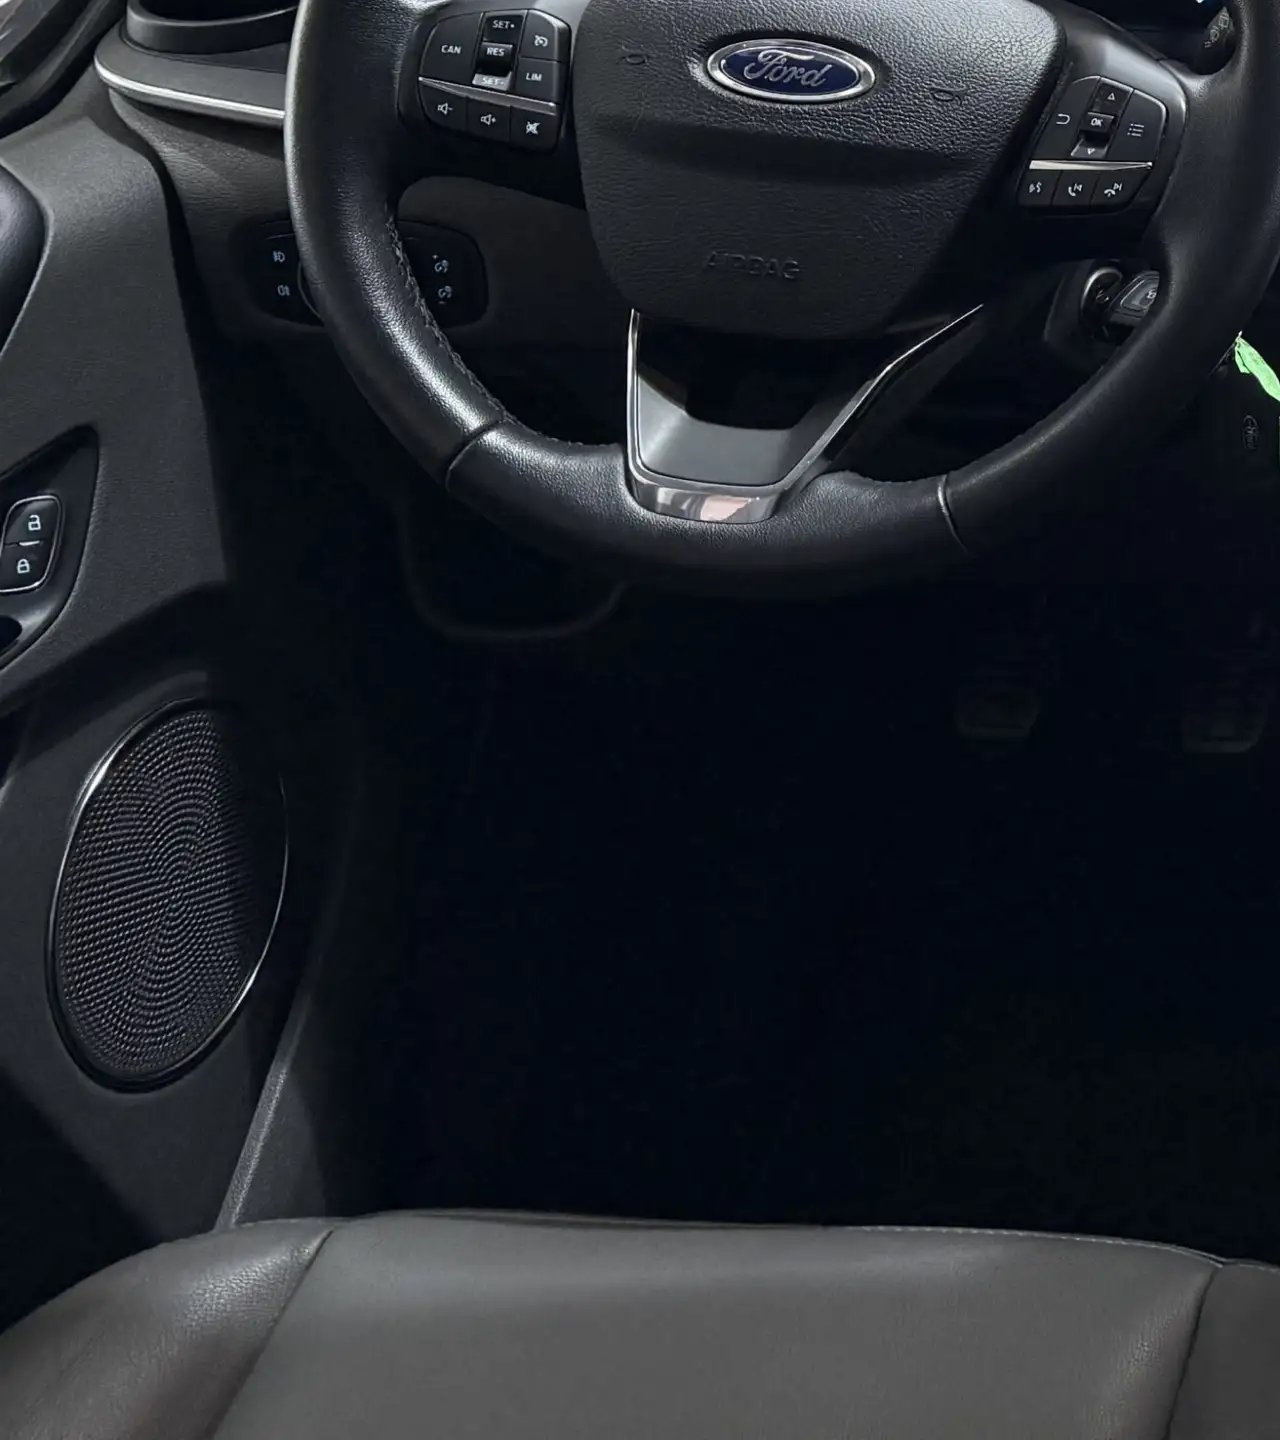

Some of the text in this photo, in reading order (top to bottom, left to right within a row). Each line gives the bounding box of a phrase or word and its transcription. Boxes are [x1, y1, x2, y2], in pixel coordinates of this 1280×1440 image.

[441, 44, 462, 55] CAN
[486, 46, 505, 57] RES
[743, 49, 833, 88] Ford
[525, 72, 543, 82] LIM
[1090, 117, 1104, 128] OK
